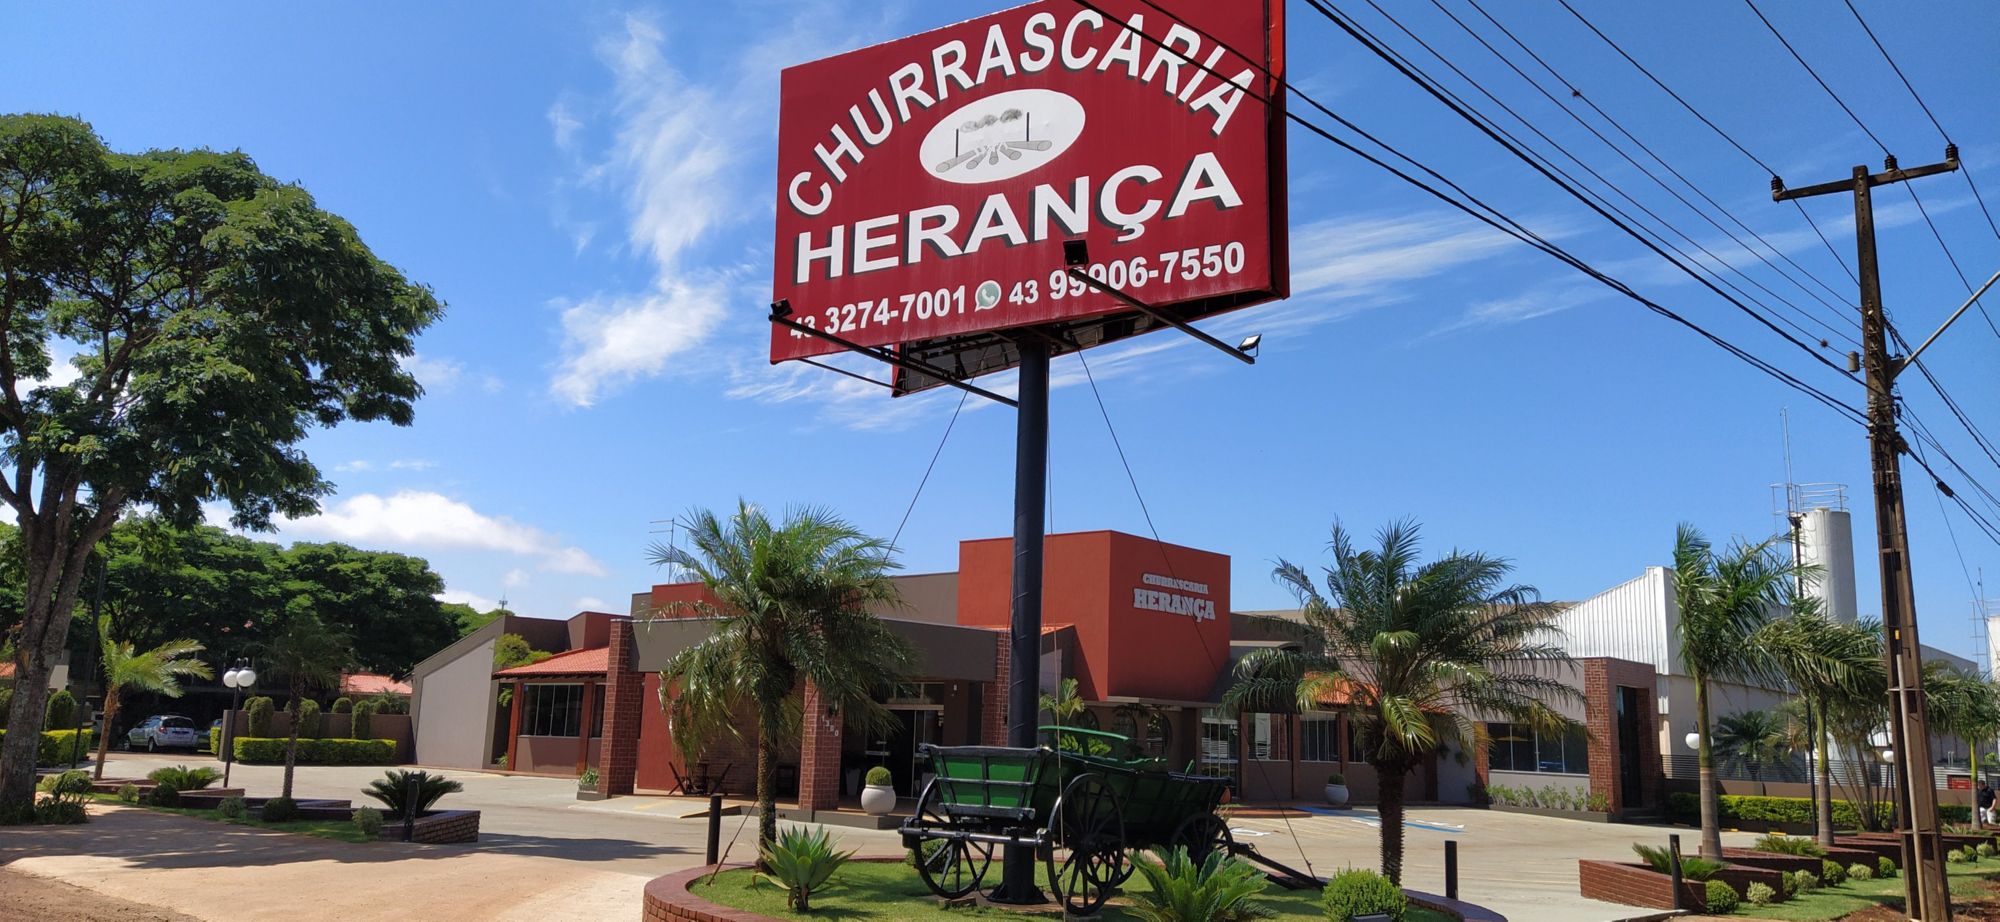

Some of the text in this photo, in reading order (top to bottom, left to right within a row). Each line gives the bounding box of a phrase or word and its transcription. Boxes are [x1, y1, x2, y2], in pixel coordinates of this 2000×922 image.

[788, 9, 1255, 216] CHURRASCARIA
[796, 152, 1243, 284] HERANÇA
[790, 241, 1245, 339] 43 3274-7001 43 99906-7550
[1133, 588, 1216, 623] HERANÇA
[1142, 573, 1208, 594] CHURRASCARIA
